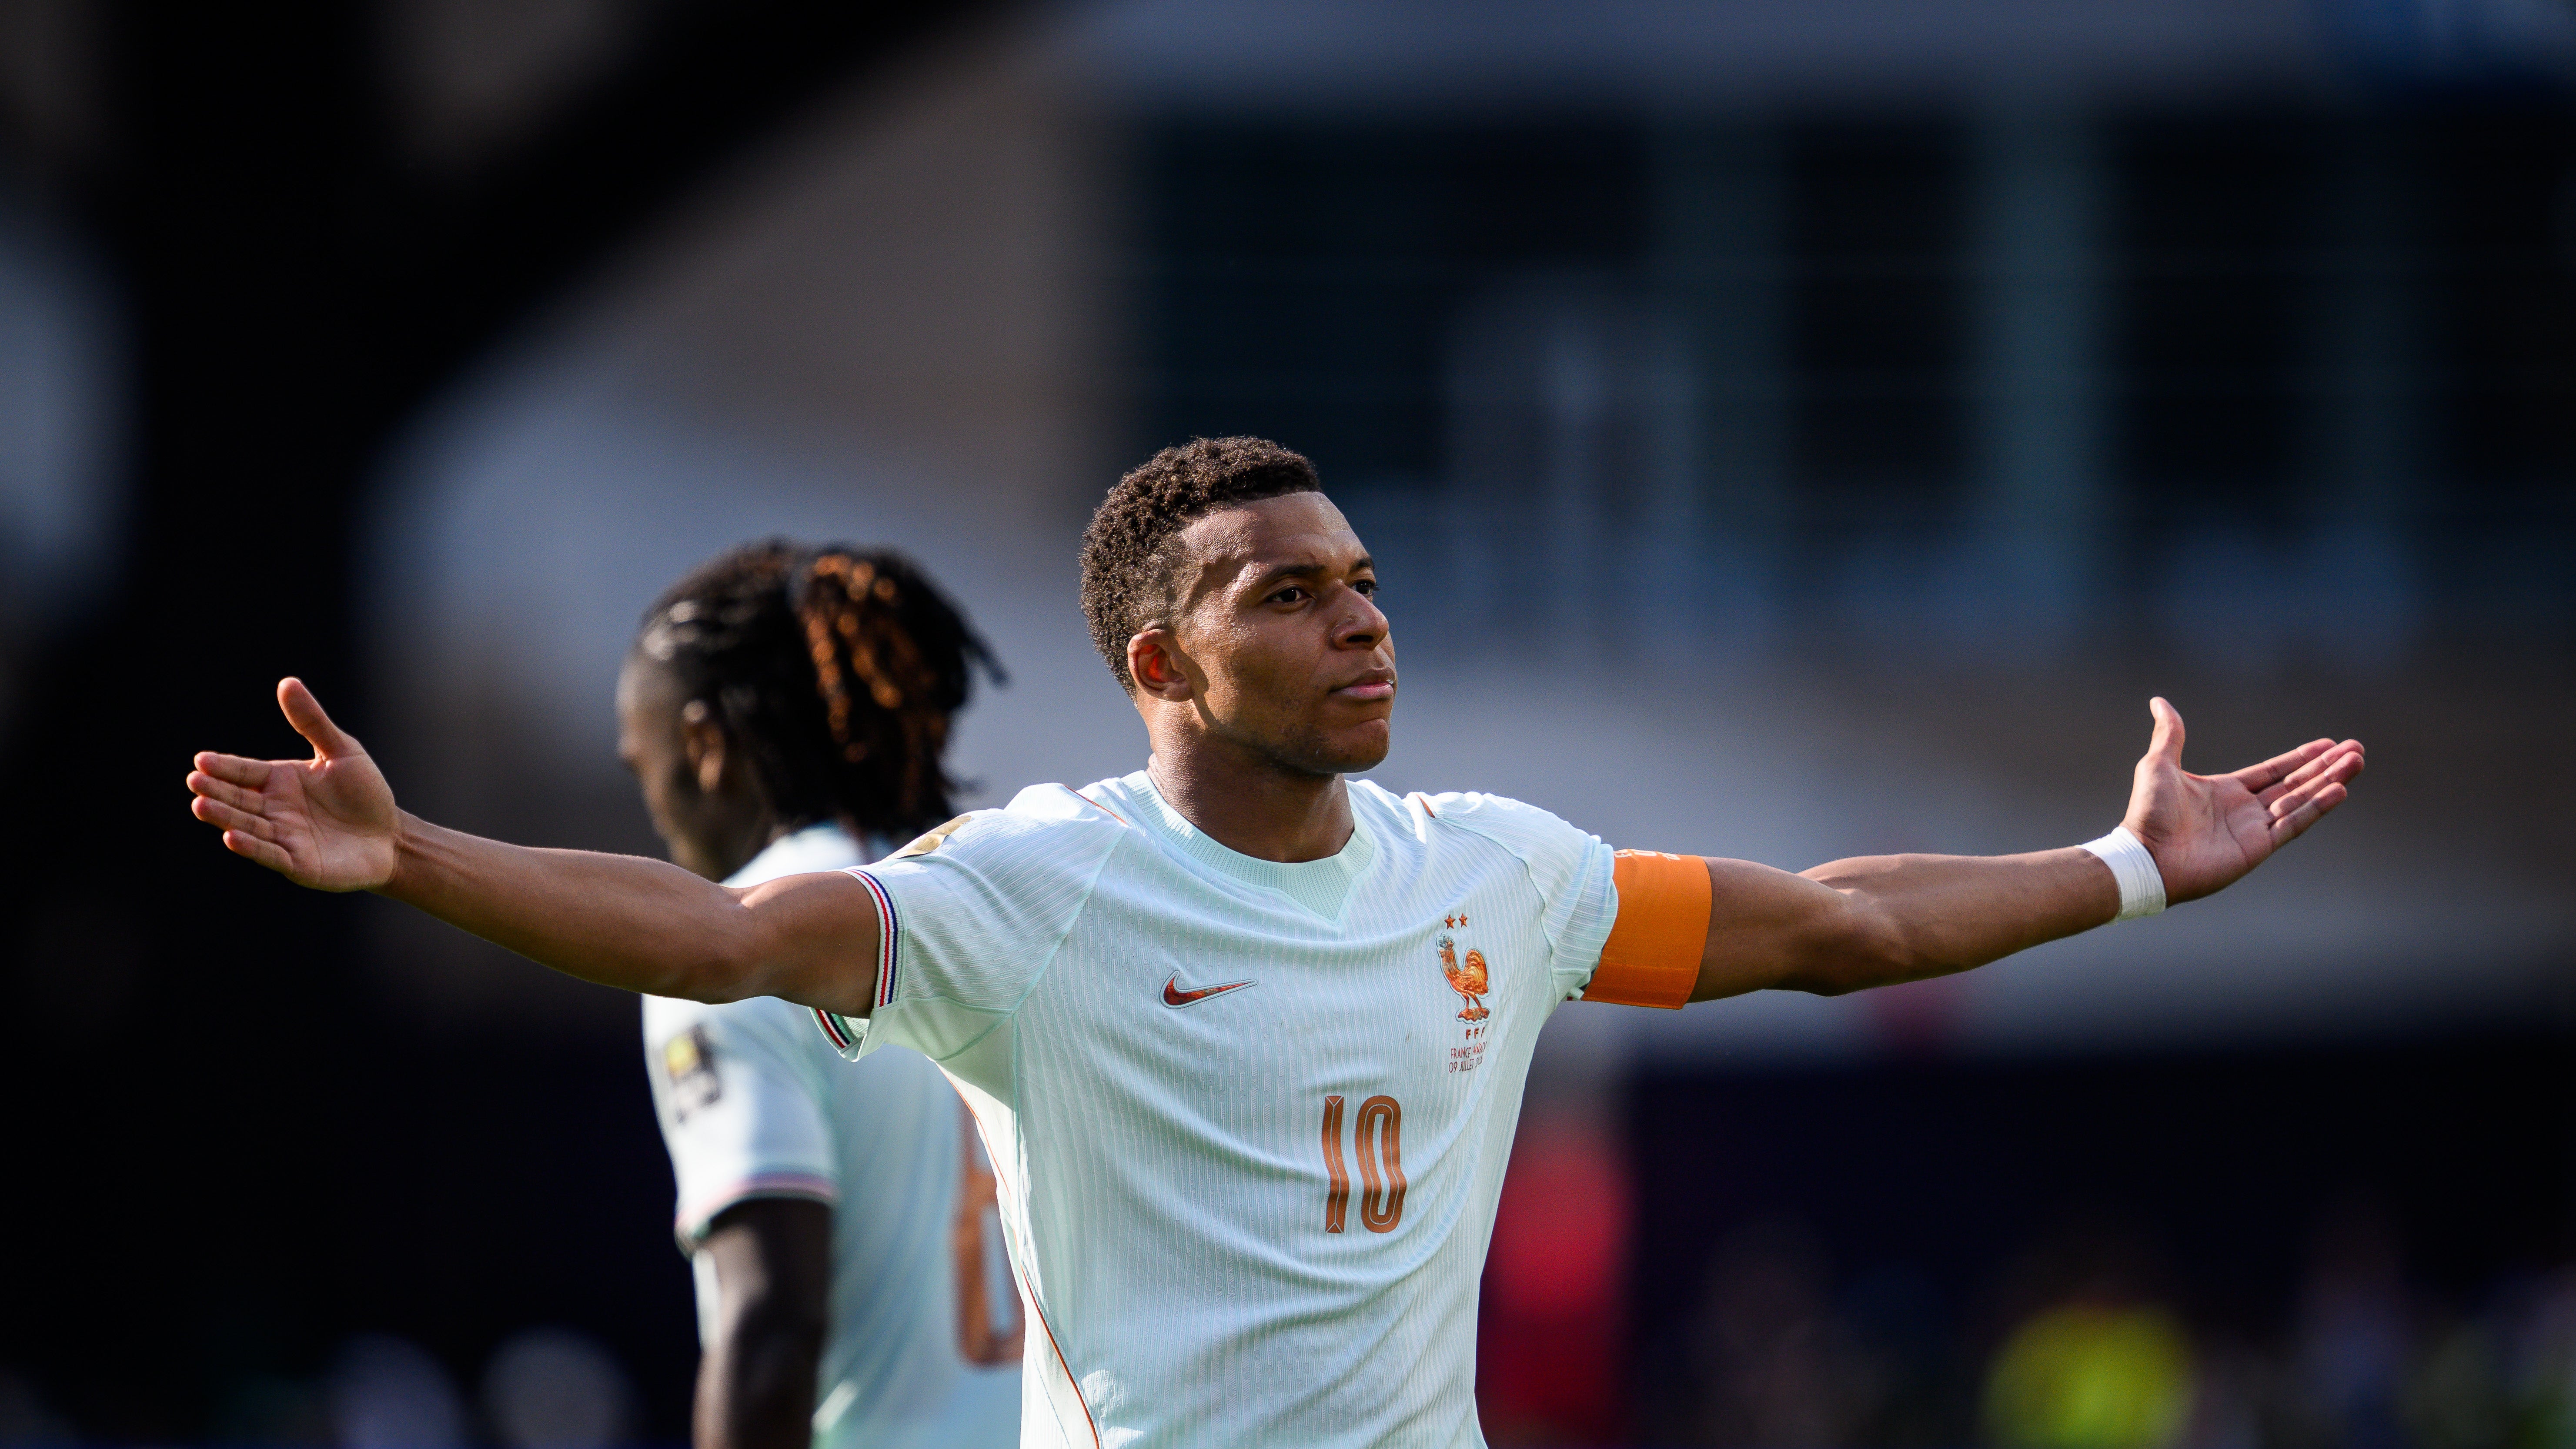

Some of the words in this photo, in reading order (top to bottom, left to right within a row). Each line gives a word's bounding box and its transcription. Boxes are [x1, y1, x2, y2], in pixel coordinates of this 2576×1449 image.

[1450, 1047, 1471, 1059] FRANCE
[1449, 1062, 1457, 1073] 09
[1322, 1095, 1407, 1233] 10
